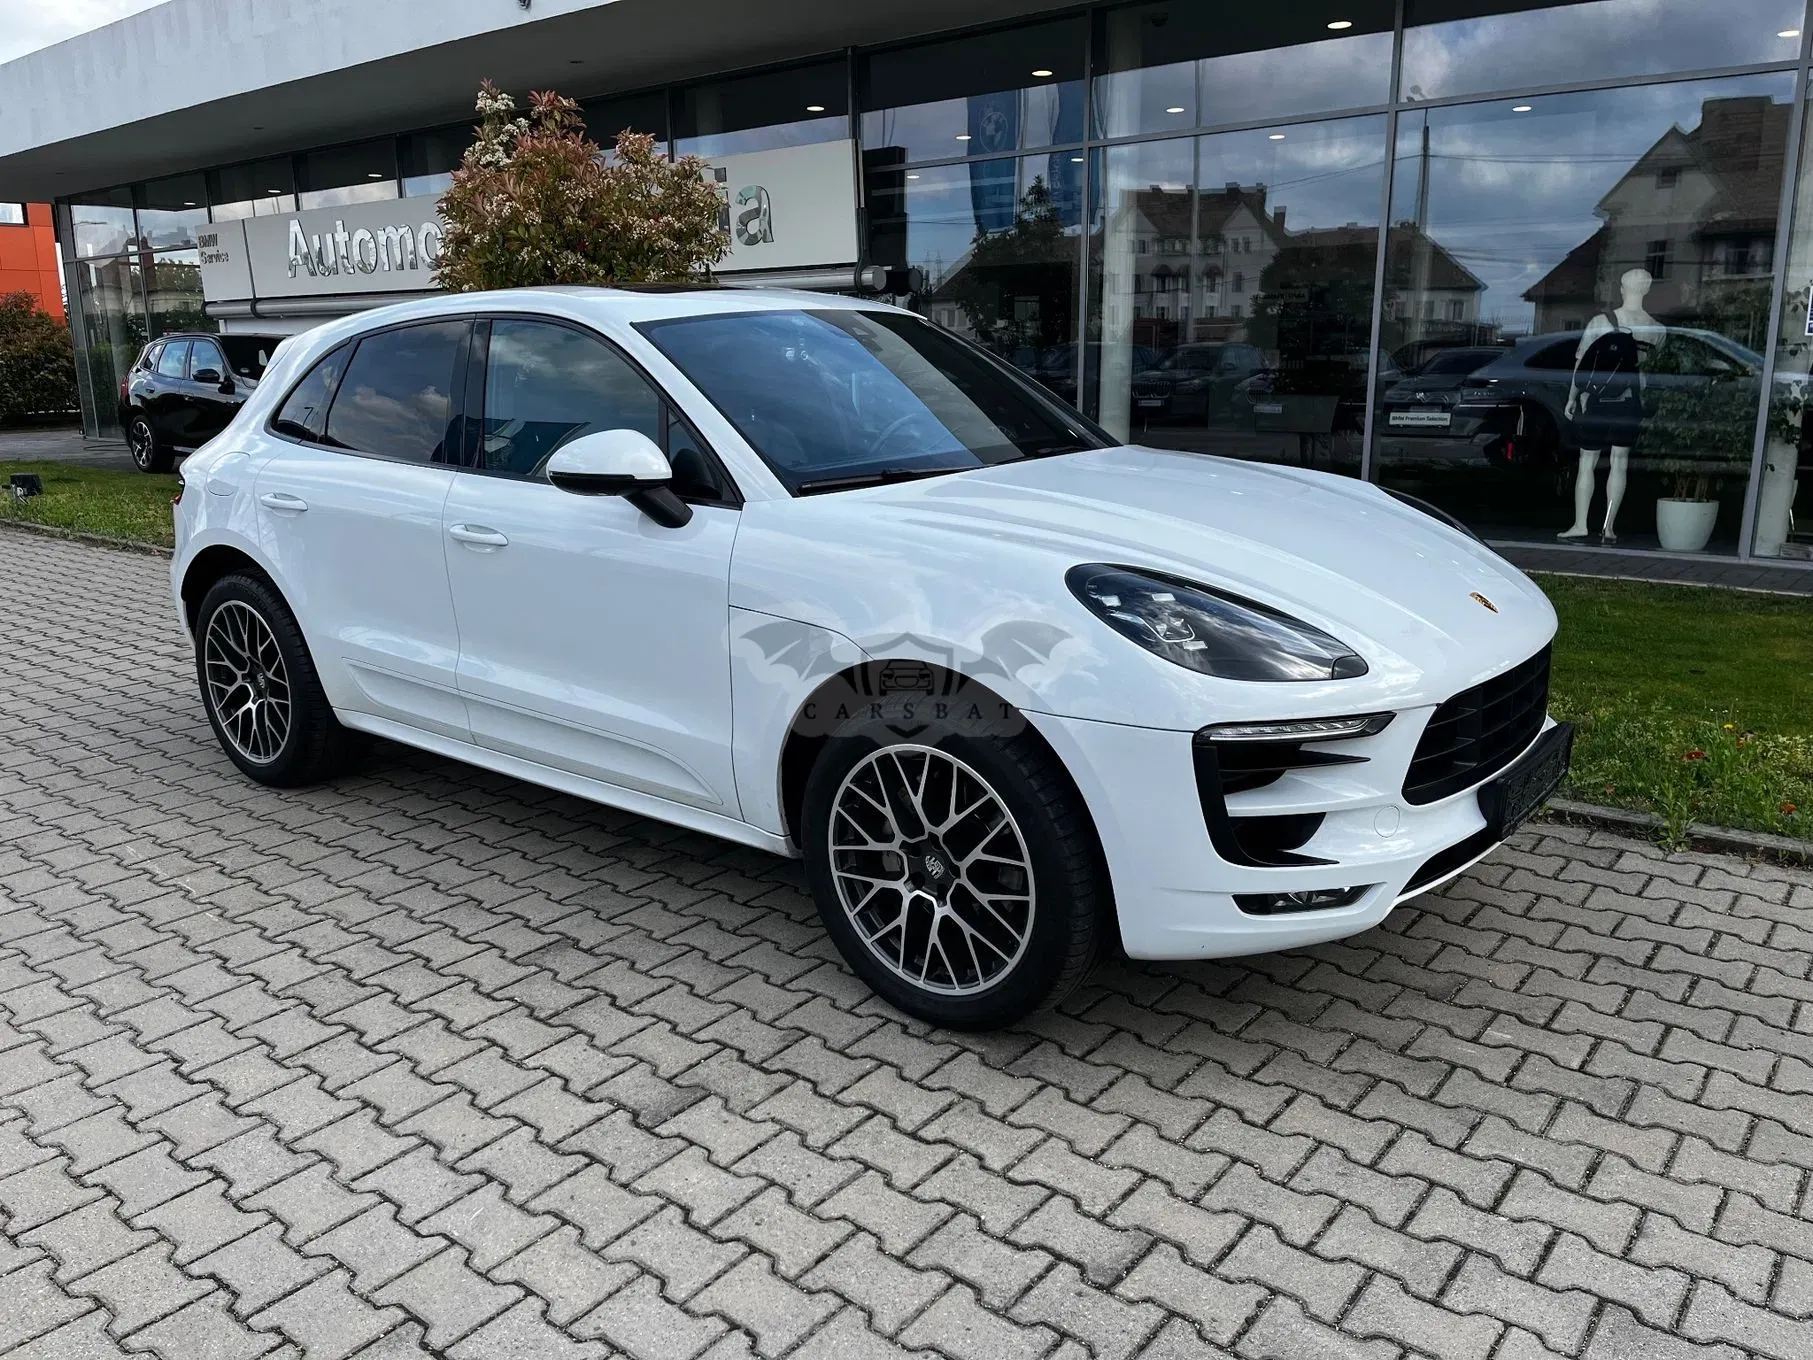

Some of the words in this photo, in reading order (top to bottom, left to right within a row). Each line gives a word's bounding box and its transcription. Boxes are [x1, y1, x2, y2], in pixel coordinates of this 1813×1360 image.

[198, 233, 218, 248] BMW
[288, 218, 445, 278] Automo
[200, 250, 229, 264] Service
